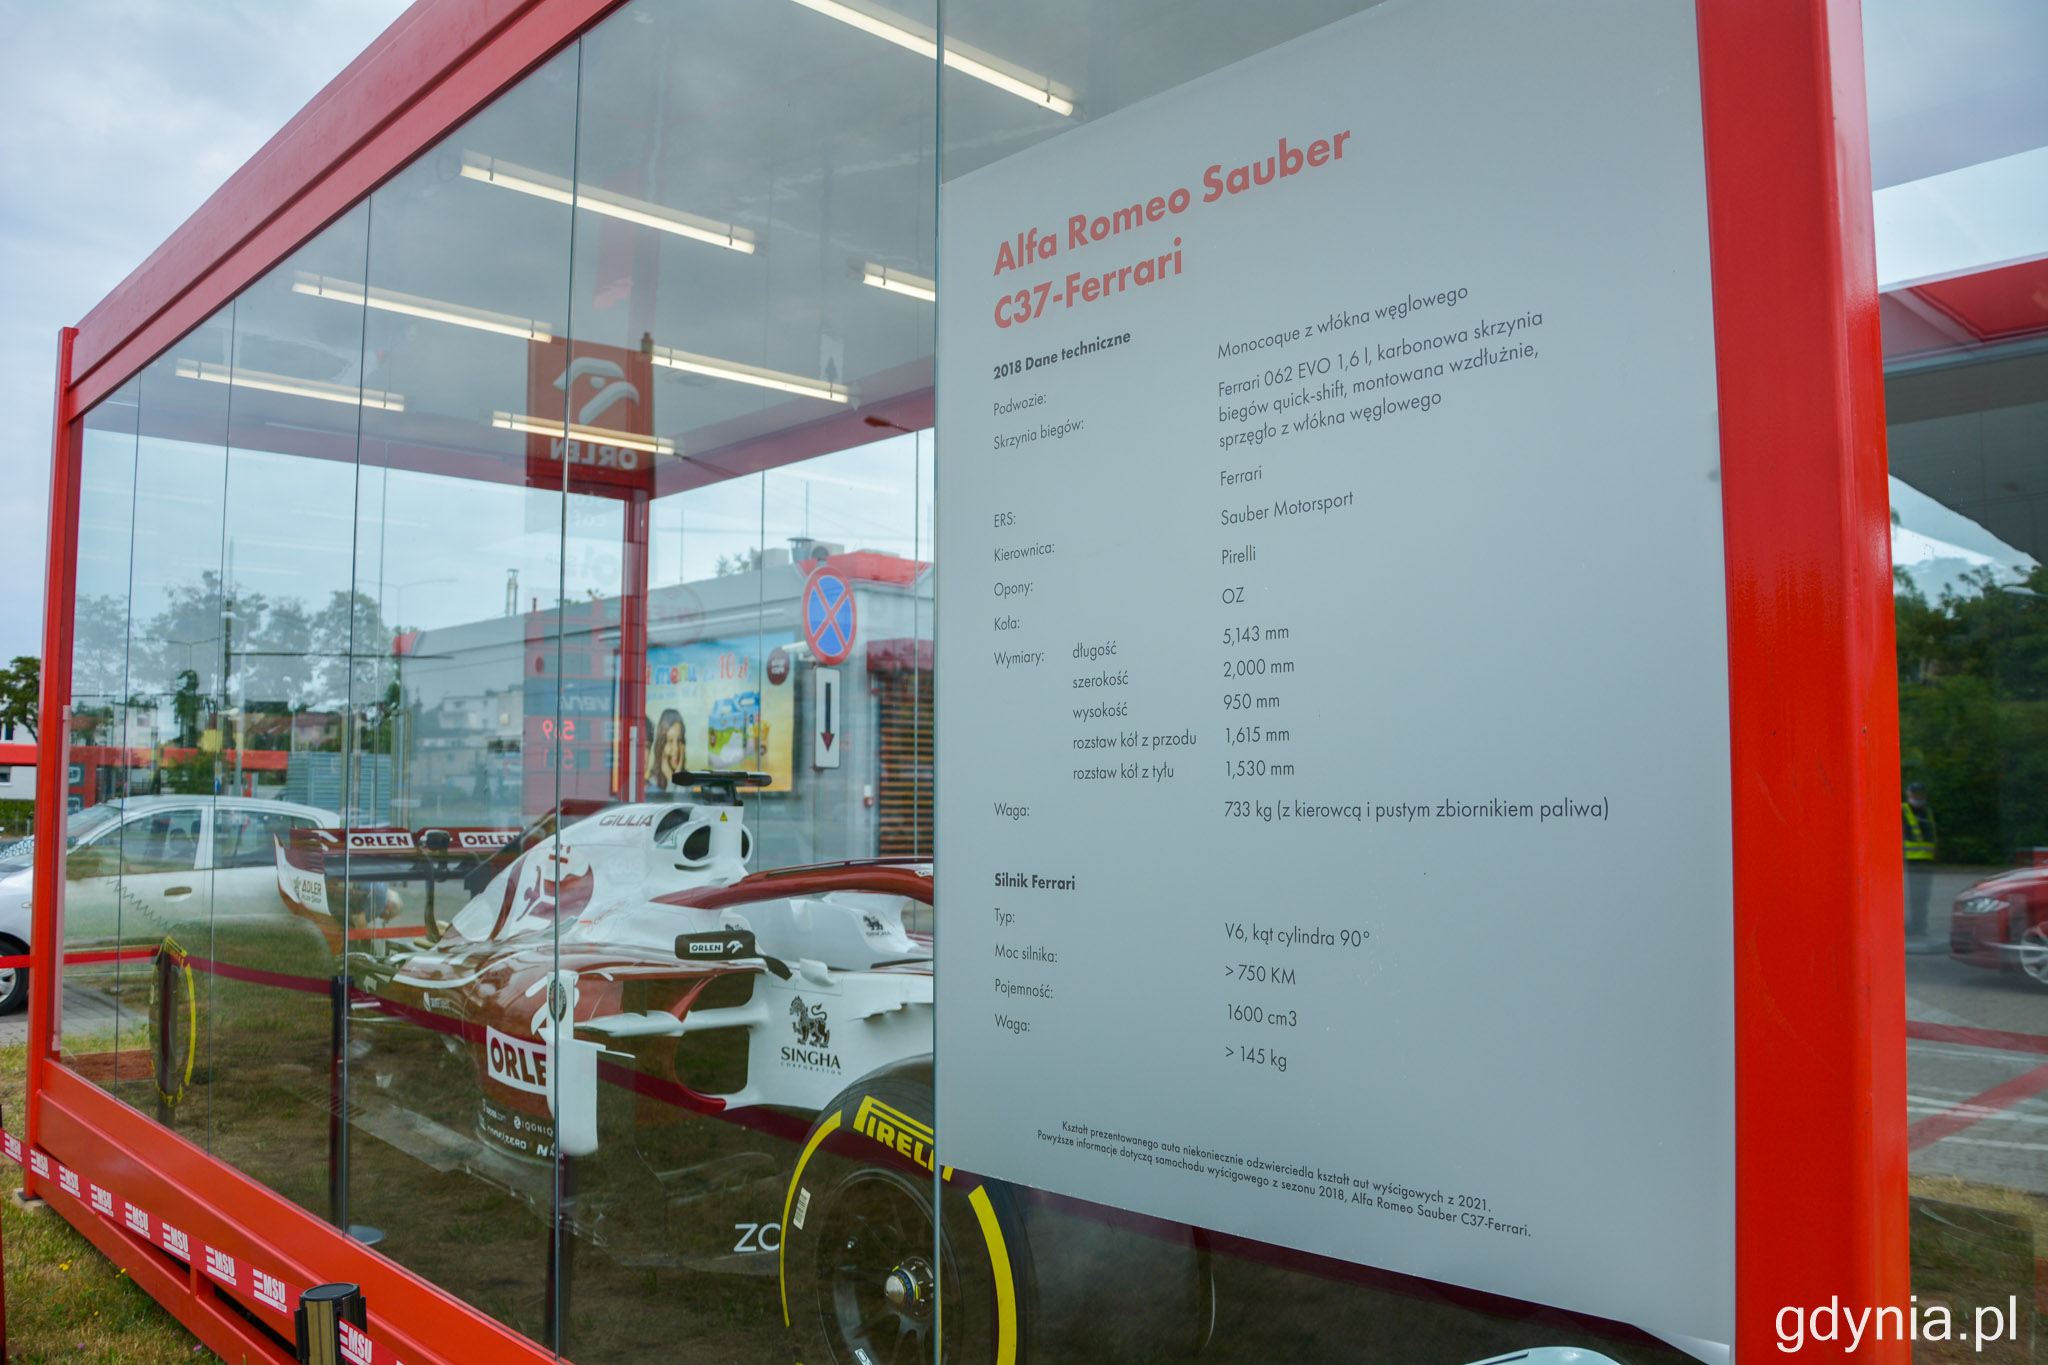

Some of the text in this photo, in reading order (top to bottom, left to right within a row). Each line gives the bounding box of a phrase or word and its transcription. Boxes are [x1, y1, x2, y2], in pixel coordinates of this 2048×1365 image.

[992, 129, 1351, 277] Alfa Romeo Sauber
[992, 237, 1183, 329] C37-Ferrari
[1217, 287, 1469, 360] Monocoque z włókna węglowego
[993, 332, 1132, 381] 2018 Dane techniczne
[1218, 311, 1543, 398] Ferrari 062 EVO 1,6 l, karbonowa skrzynia
[1218, 344, 1539, 423] biegów quick-shift, montowana wzdłużnie,
[993, 392, 1047, 417] Podwozie:
[1219, 392, 1442, 452] sprzęgło z włókna węglowego
[993, 418, 1085, 450] Skrzynia biegów:
[1220, 464, 1262, 487] Ferrari
[1220, 490, 1354, 526] Sauber Motorsport
[993, 511, 1016, 529] ERS:
[993, 541, 1055, 563] Kierownica:
[1221, 543, 1256, 566] Pirelli
[993, 581, 1033, 600] Opony:
[1221, 586, 1245, 605] OZ
[994, 614, 1021, 632] Koła:
[1222, 624, 1290, 648] 5,143 mm
[993, 650, 1045, 670] Wymiary:
[1072, 639, 1118, 662] długość
[718, 653, 736, 680] 10
[1223, 658, 1295, 680] 2,000 mm
[1072, 669, 1129, 689] szerokość
[1072, 700, 1128, 724] wysokość
[1223, 692, 1280, 711] 950 mm
[1072, 727, 1197, 752] rozstaw kół z przodu
[1225, 725, 1290, 747] 1,615 mm
[1072, 760, 1175, 784] rozstaw kół z tyłu
[1225, 759, 1295, 780] 1,530 mm
[599, 814, 654, 827] GIULIA
[993, 801, 1030, 821] Waga:
[1224, 795, 1609, 824] 733 kg (z kierowcą i pustym zbiornikiem paliwa)
[350, 835, 409, 848] ORLEN
[302, 879, 322, 897] ADLER
[994, 871, 1076, 891] Silnik Ferrari
[993, 907, 1016, 928] Typ:
[1224, 921, 1248, 944] V6,
[1252, 922, 1274, 946] kąt
[1277, 924, 1335, 949] cylindra
[691, 944, 721, 952] ORLEN
[994, 943, 1058, 964] Moc silnika:
[1237, 963, 1267, 983] 750
[1271, 966, 1296, 985] KM
[994, 977, 1054, 1000] Pojemność:
[994, 1012, 1031, 1035] Waga:
[1227, 1003, 1298, 1028] 1600 cm3
[490, 1036, 547, 1087] ORLE
[781, 1046, 841, 1069] SINGHA
[1240, 1045, 1266, 1065] 145
[1270, 1047, 1287, 1073] kg
[1061, 1120, 1492, 1213] Kształt prezentowanego auta niekoniecznie odzwierciedla kształt aut wyścigowych z 2021.
[1037, 1129, 1532, 1238] Powyższe informacje dotyczą samochodu wyścigowego z sezonu 2018, Alfa Romeo Sauber C37-Ferrari.
